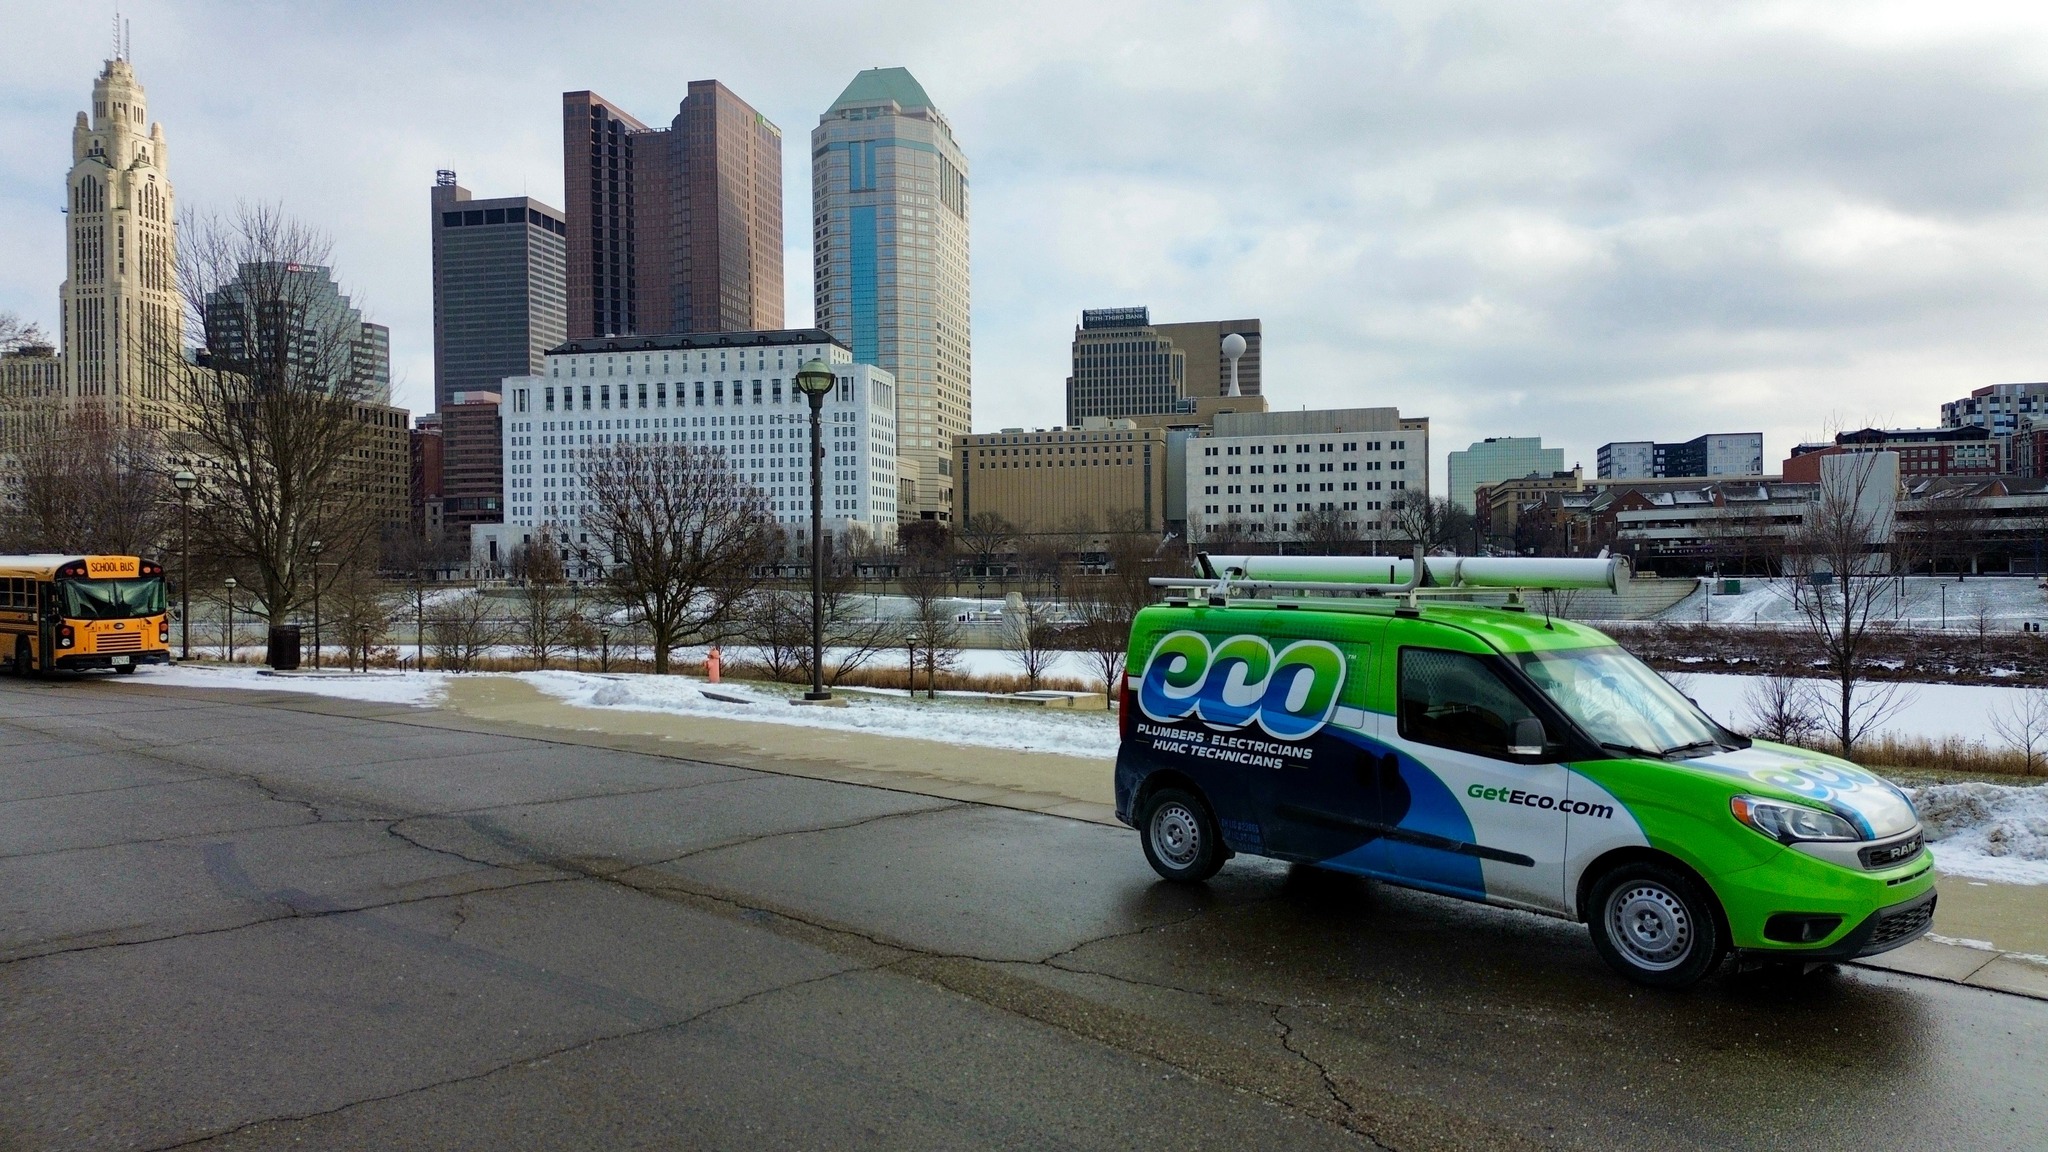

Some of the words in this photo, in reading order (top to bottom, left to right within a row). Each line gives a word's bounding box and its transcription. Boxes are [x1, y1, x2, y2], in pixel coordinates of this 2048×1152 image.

[91, 562, 118, 572] SCHOOL
[120, 562, 134, 571] BUS
[1138, 630, 1346, 740] eco
[1137, 723, 1204, 743] PLUMBERS
[1211, 735, 1313, 760] ELECTRICIANS
[1153, 739, 1188, 754] HVAC
[1190, 745, 1283, 770] TECHNICIANS
[1467, 783, 1614, 819] GetEco.com
[1890, 841, 1917, 859] RAM
